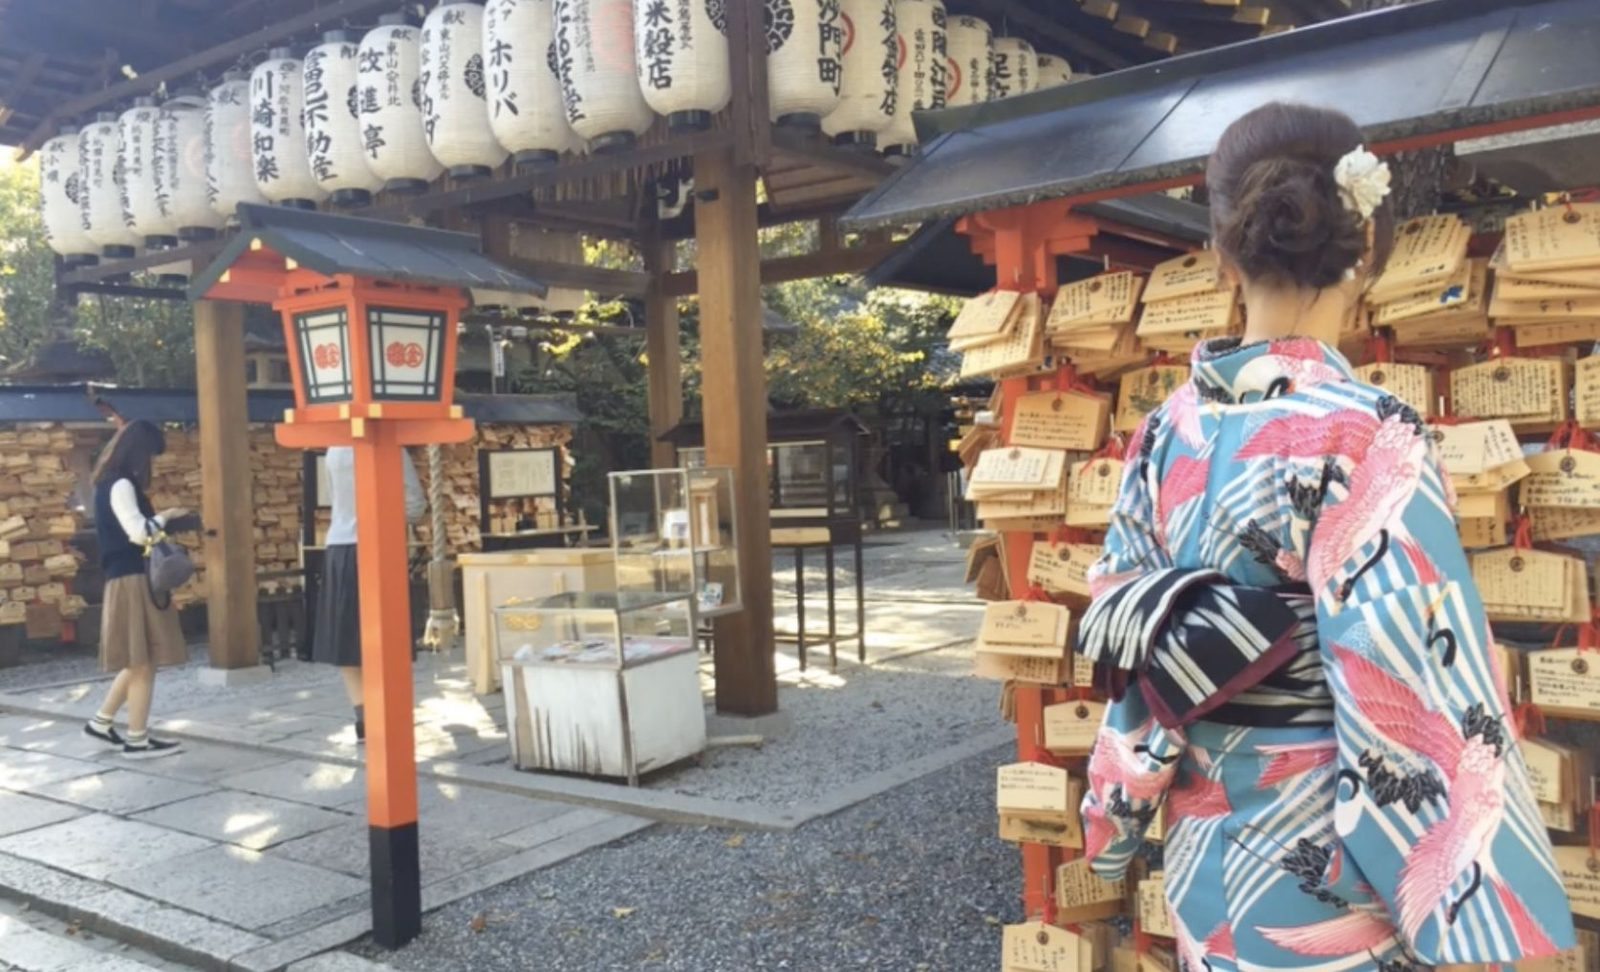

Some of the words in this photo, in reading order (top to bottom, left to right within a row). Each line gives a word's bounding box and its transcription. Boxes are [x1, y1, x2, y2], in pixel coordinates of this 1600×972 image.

[489, 39, 519, 118] ホリバ
[644, 0, 675, 90] 米穀店
[252, 70, 280, 182] 川崎和楽
[358, 47, 386, 159] 改進亭
